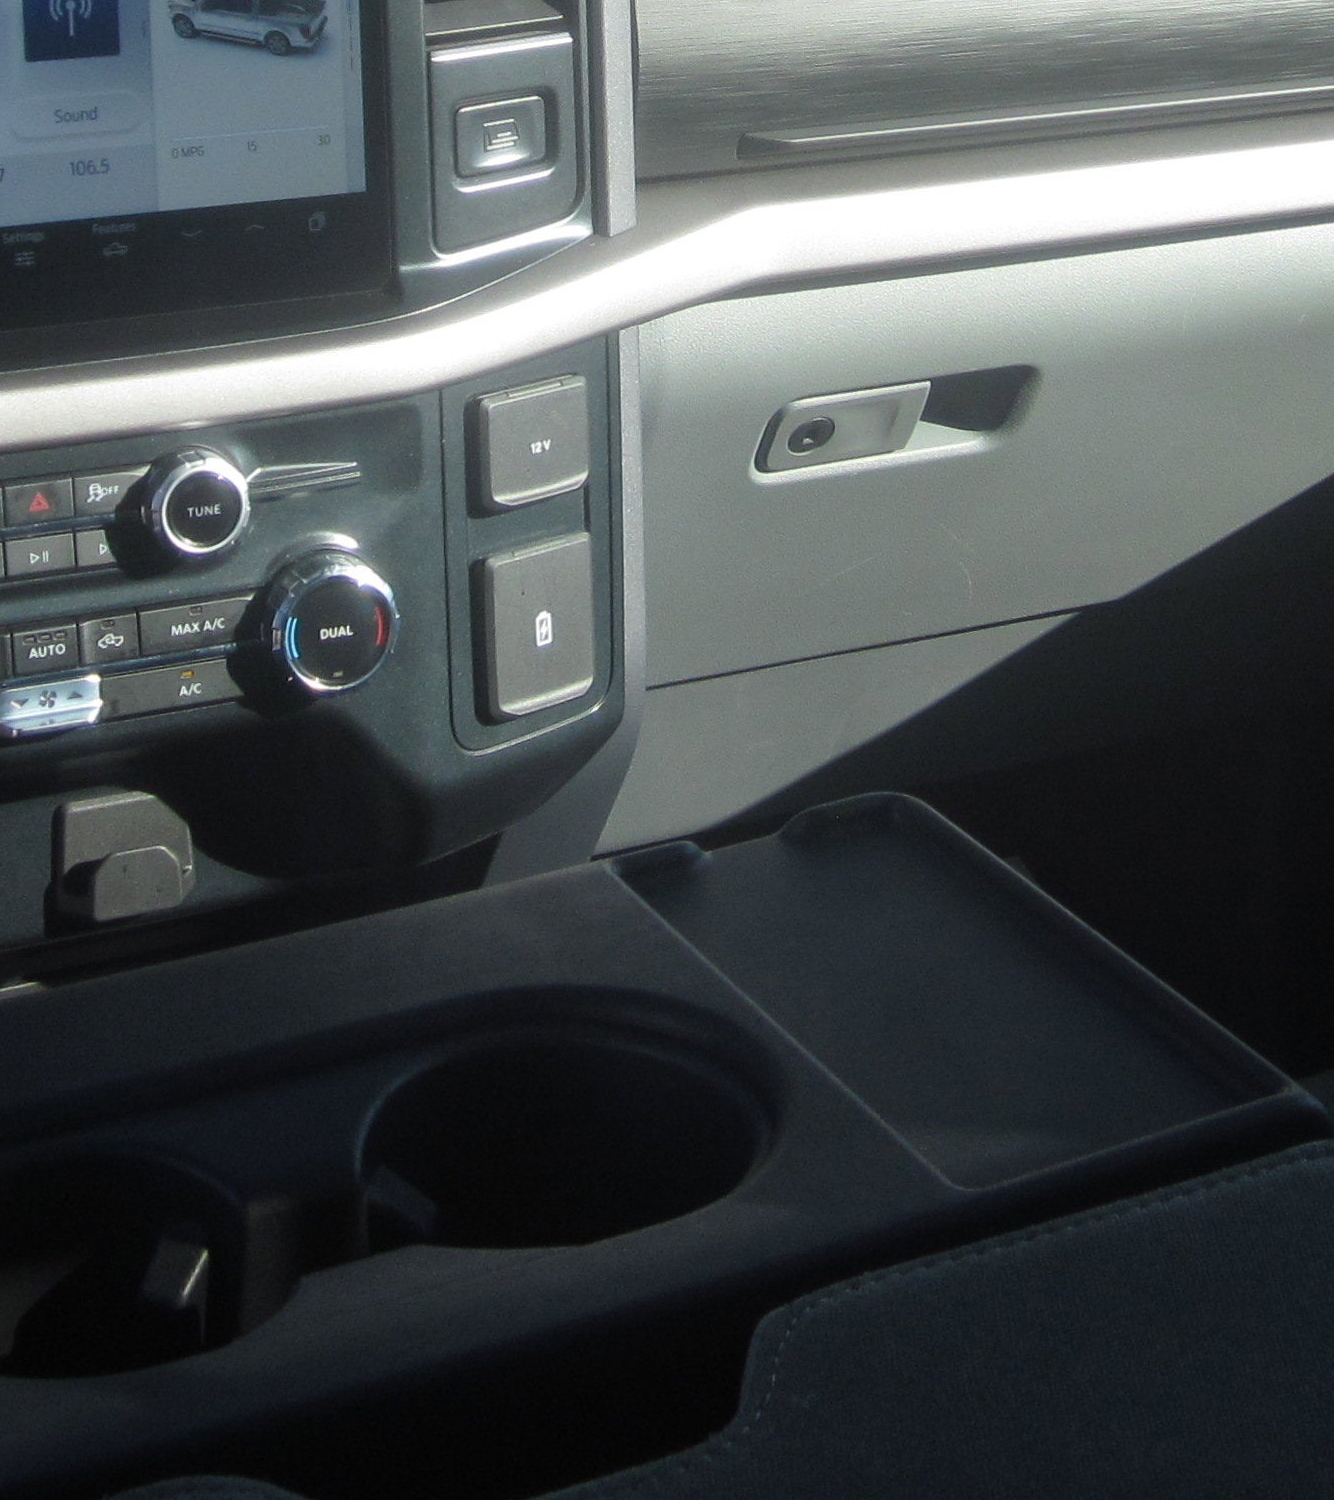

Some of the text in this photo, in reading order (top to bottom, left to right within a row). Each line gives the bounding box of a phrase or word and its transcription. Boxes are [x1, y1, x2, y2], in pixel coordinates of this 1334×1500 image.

[54, 106, 99, 125] Sound
[69, 158, 110, 177] 106.5
[530, 441, 542, 454] 12
[101, 484, 119, 496] OFF
[186, 503, 222, 519] TUNE
[171, 617, 226, 637] MAX A/C
[319, 625, 354, 641] DUAL
[28, 643, 66, 660] AUTO
[179, 682, 203, 697] A/C
